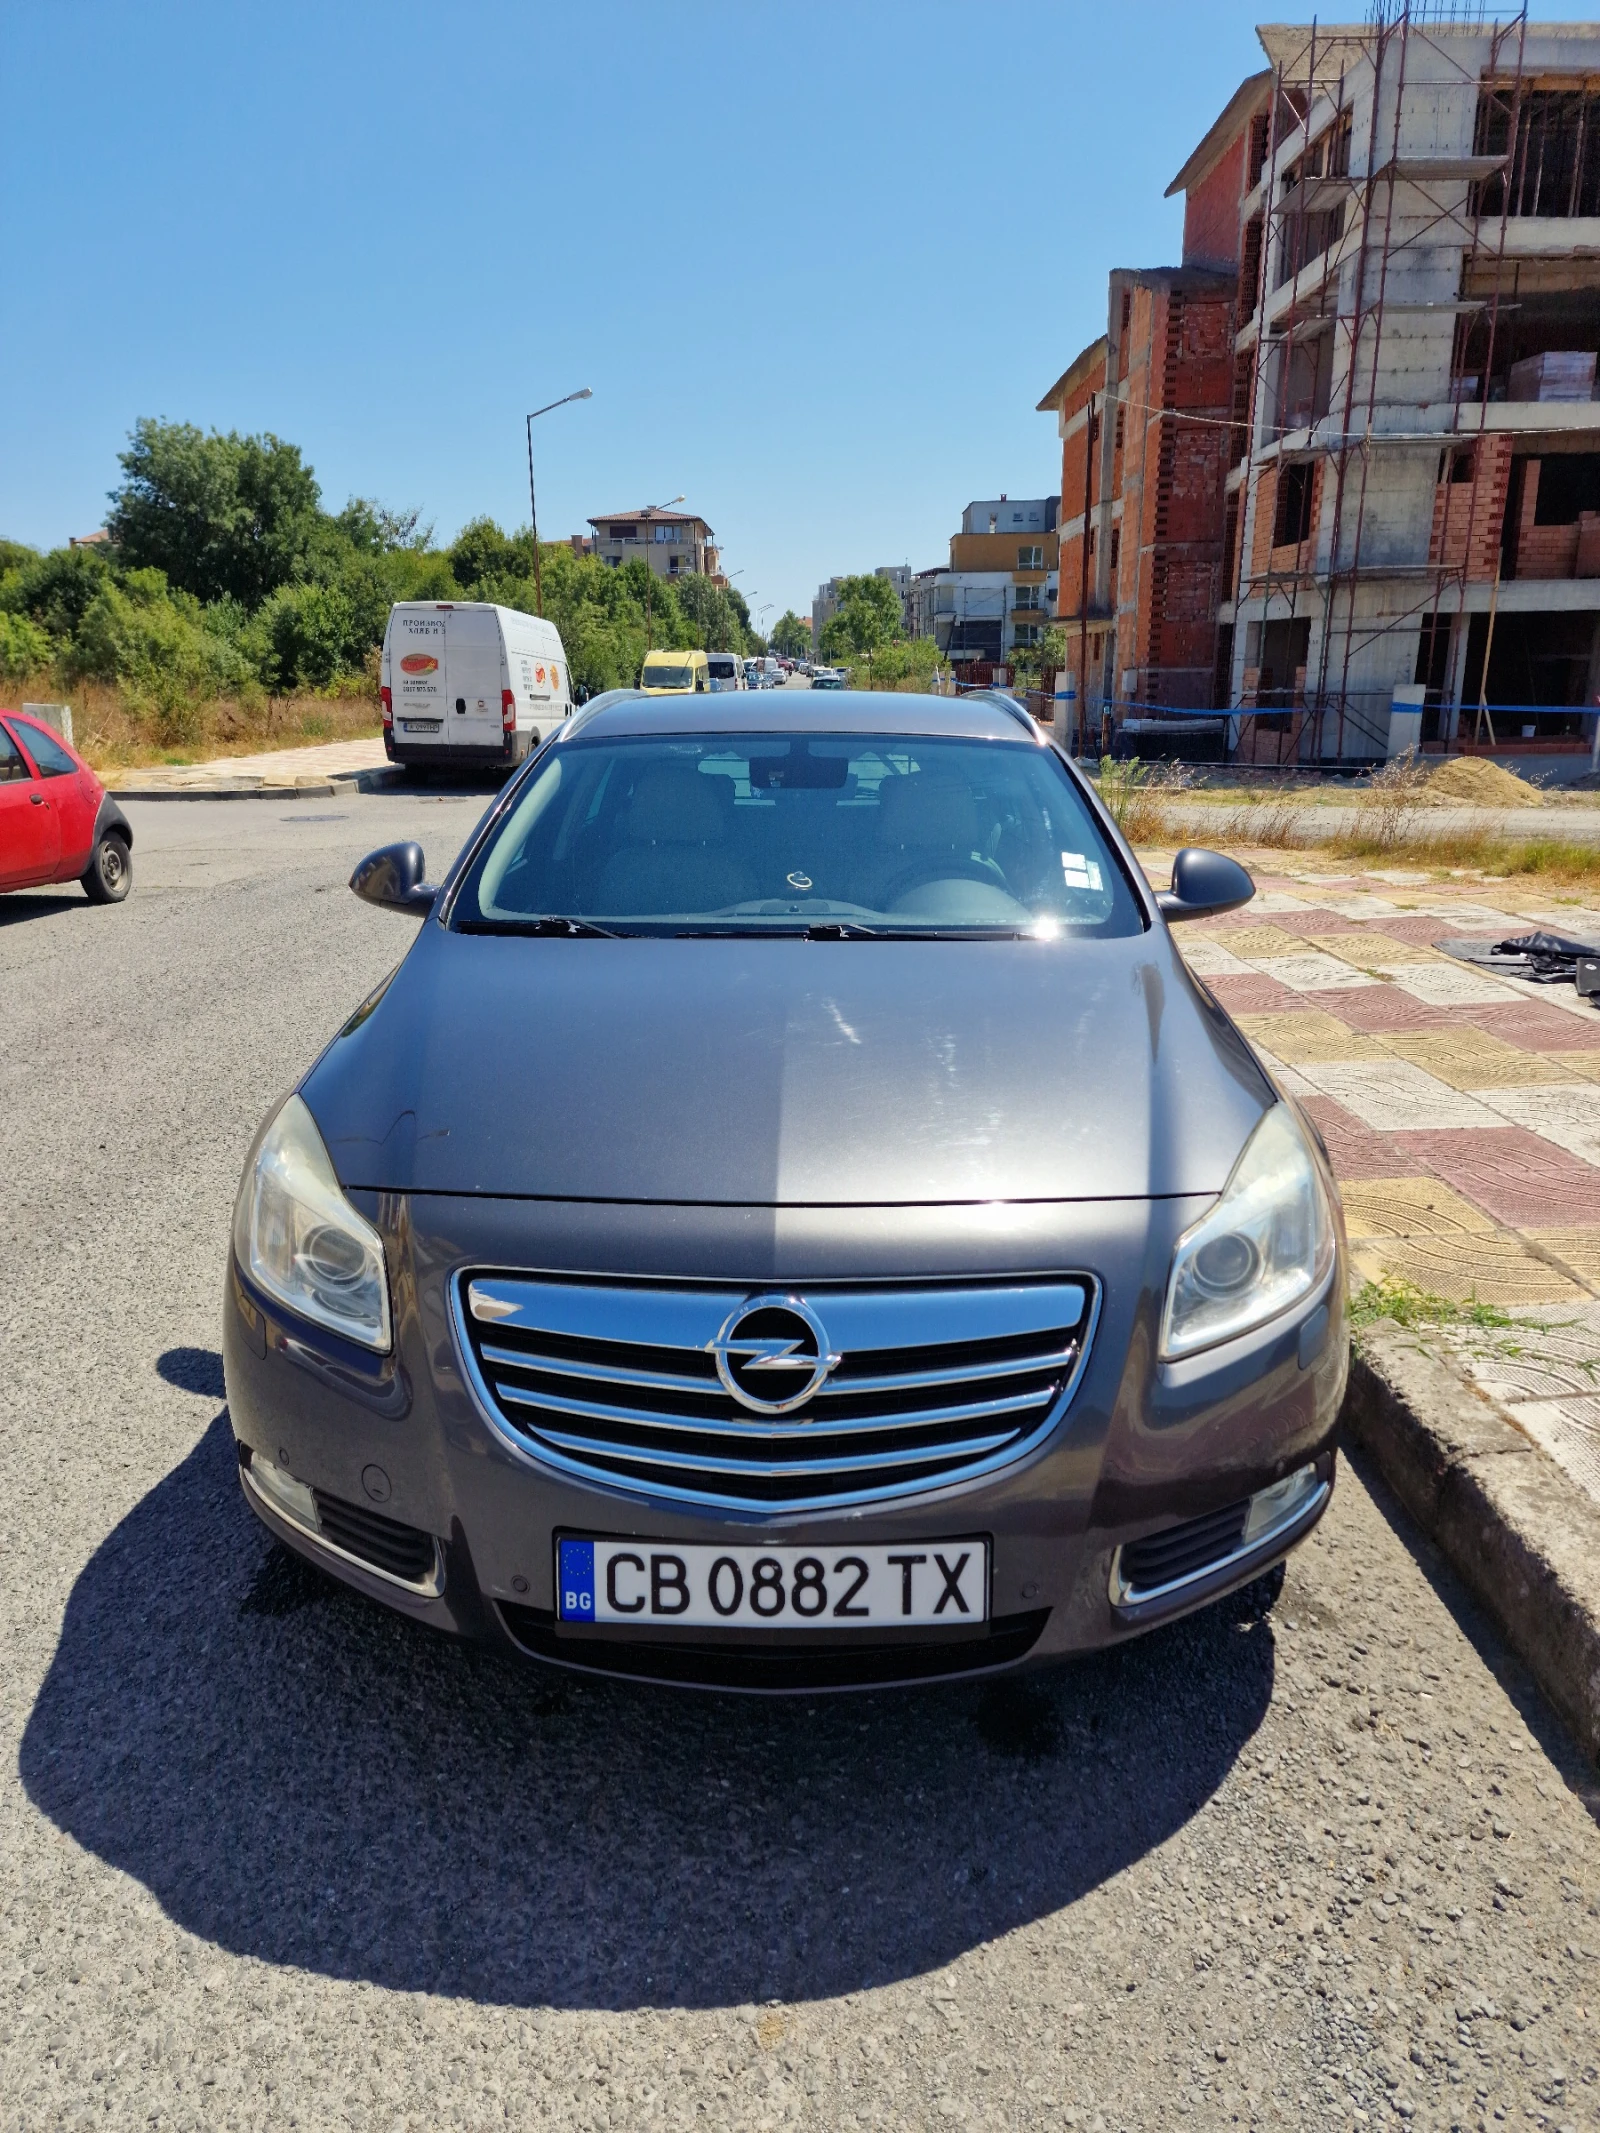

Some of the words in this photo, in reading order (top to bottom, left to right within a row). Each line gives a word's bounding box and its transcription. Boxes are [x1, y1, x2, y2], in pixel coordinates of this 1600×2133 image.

[408, 627, 430, 635] ХЛЯБ
[565, 1591, 592, 1611] BG
[606, 1553, 691, 1615] CB
[708, 1556, 870, 1618] 0882
[887, 1553, 971, 1616] TX
